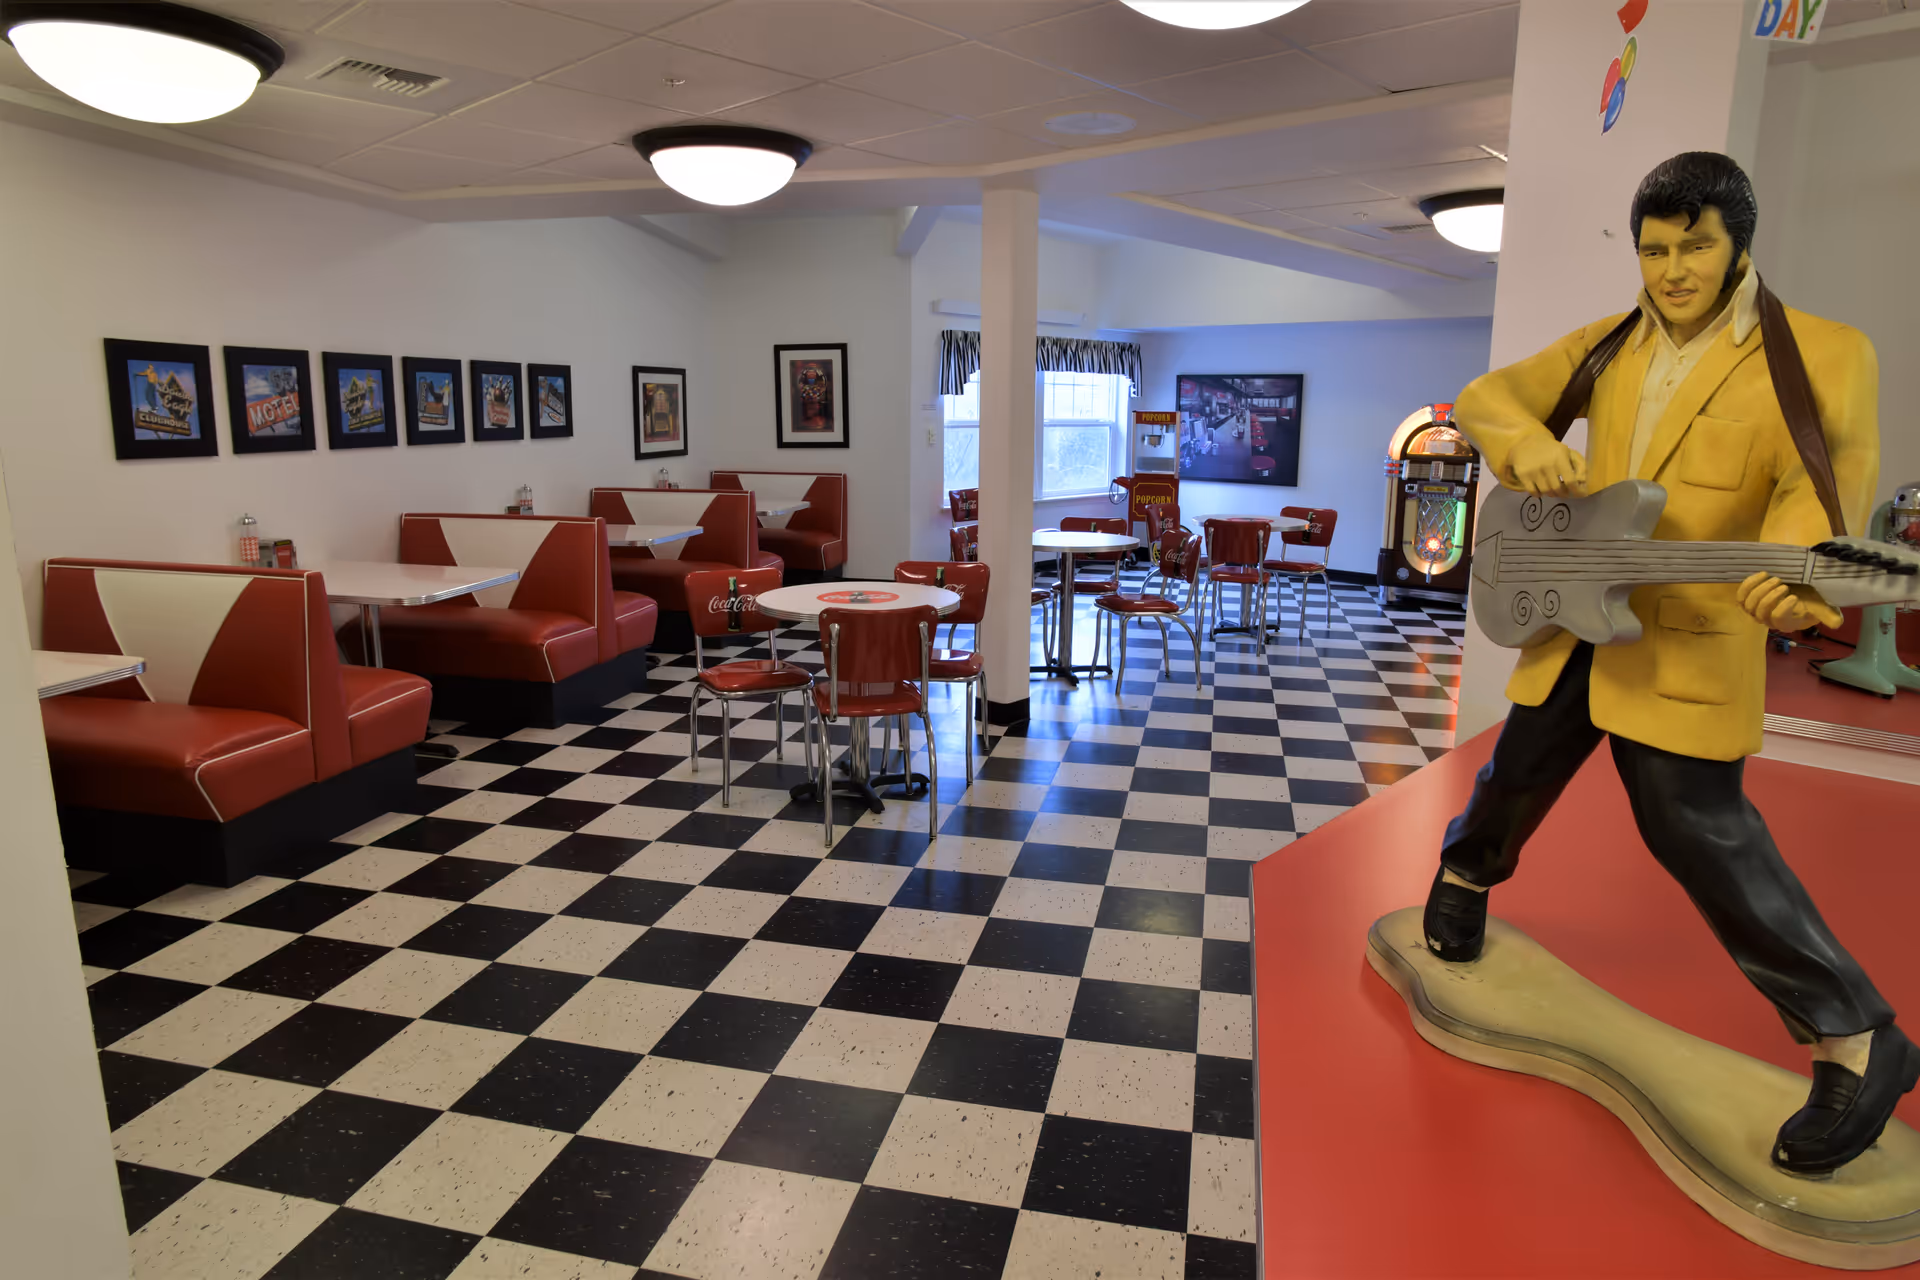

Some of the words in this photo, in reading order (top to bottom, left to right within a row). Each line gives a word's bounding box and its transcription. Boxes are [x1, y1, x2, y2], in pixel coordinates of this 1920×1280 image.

[249, 393, 300, 426] MOTEL
[1142, 413, 1170, 422] POPCORN
[1135, 495, 1172, 504] POPCORN
